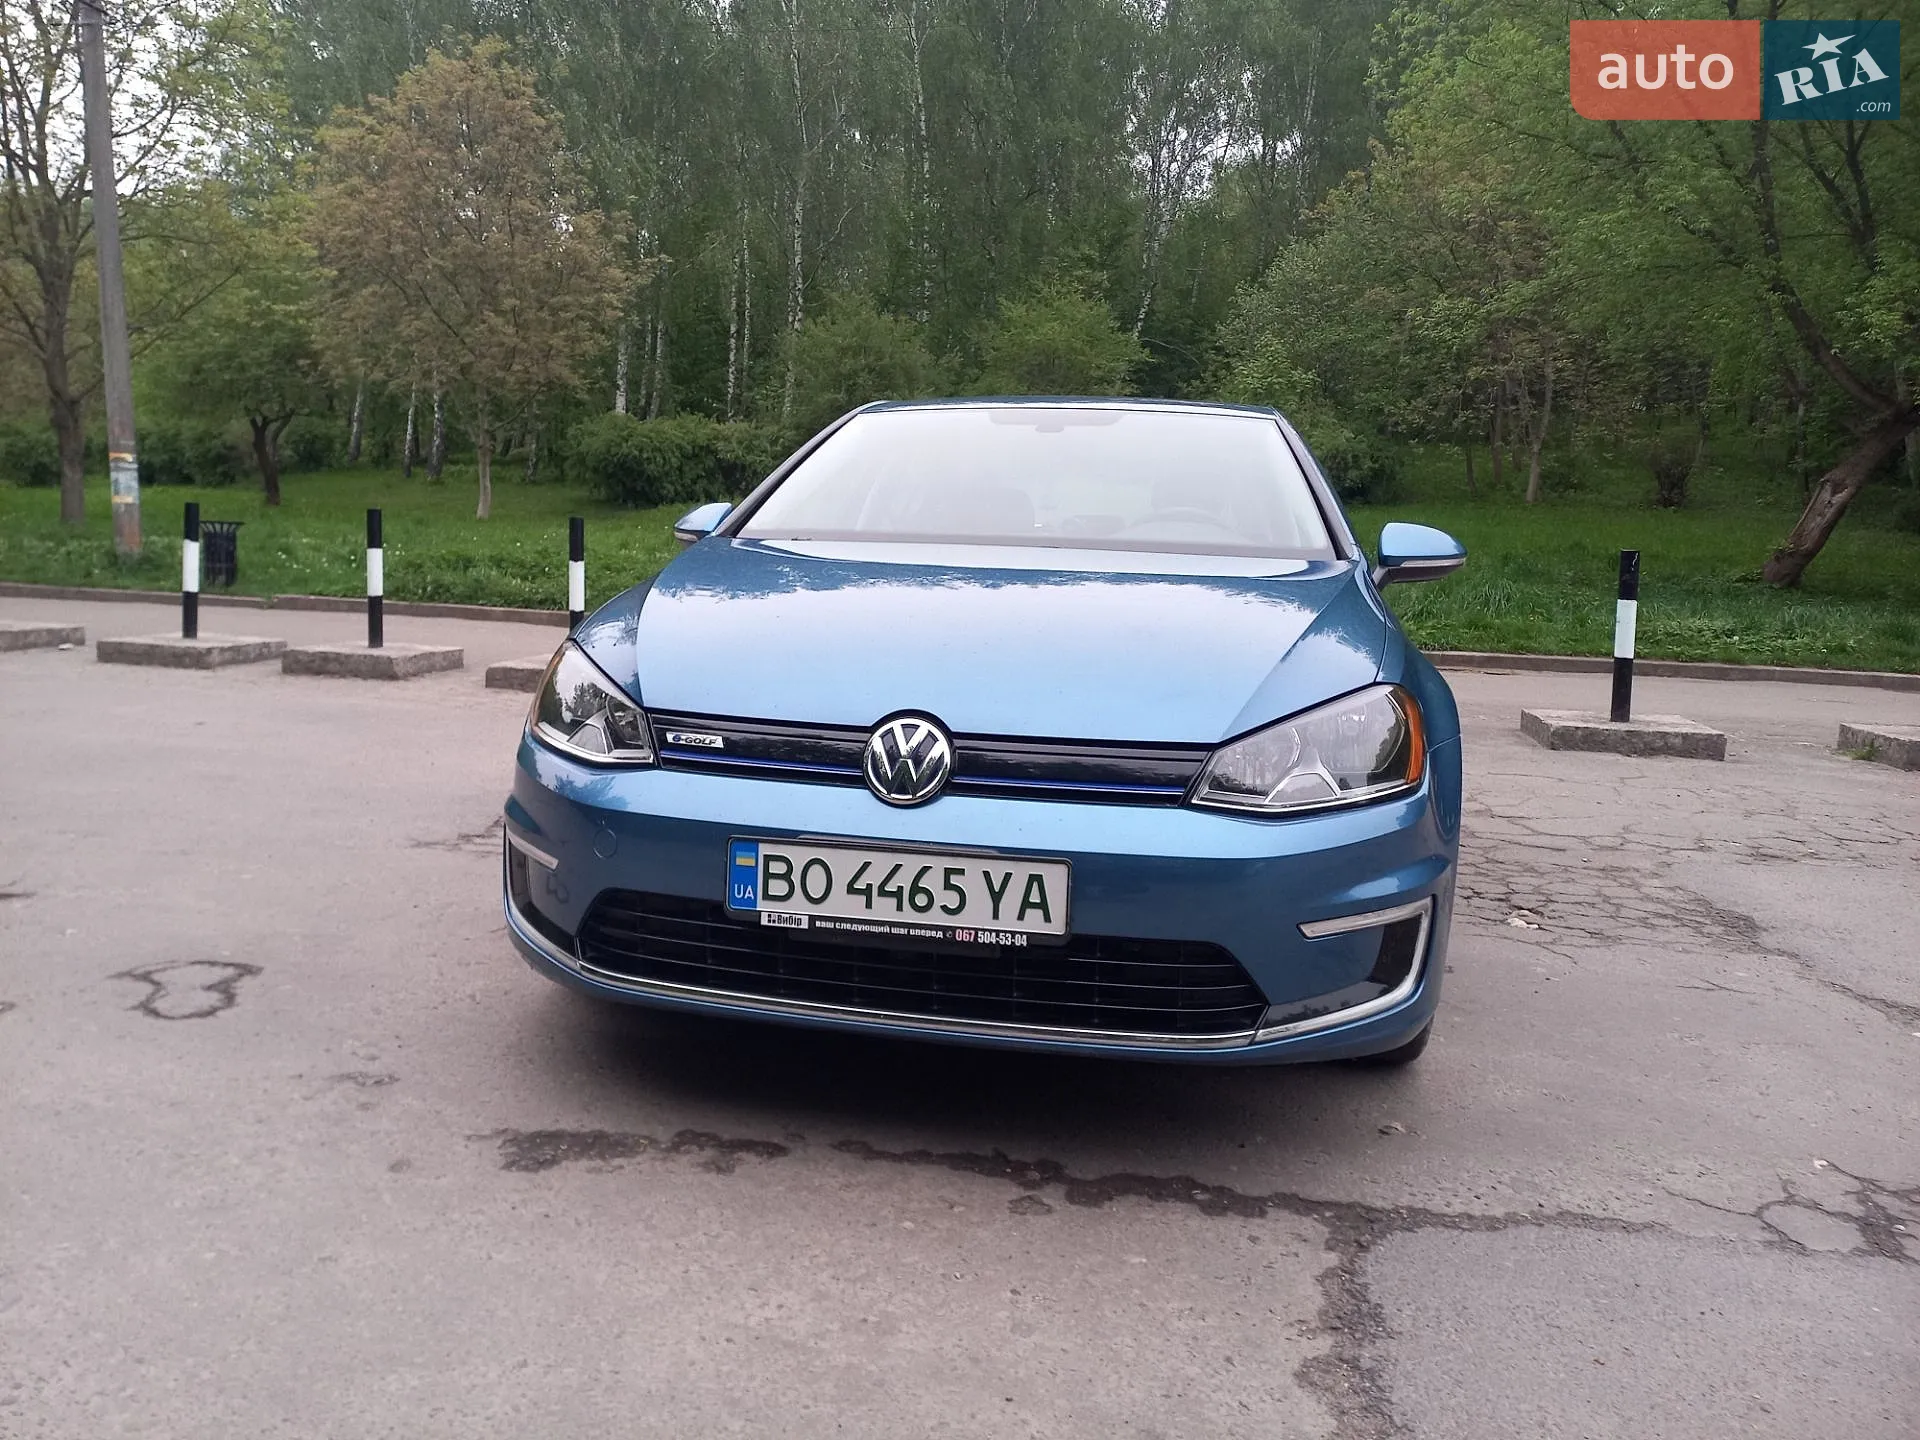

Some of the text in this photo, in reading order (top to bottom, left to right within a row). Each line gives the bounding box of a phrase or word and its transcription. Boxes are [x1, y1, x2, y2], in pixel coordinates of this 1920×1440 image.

[734, 883, 755, 900] UA
[762, 853, 1053, 924] BO 4465 YA
[955, 928, 976, 942] 067
[977, 930, 1028, 947] 504-53-04
